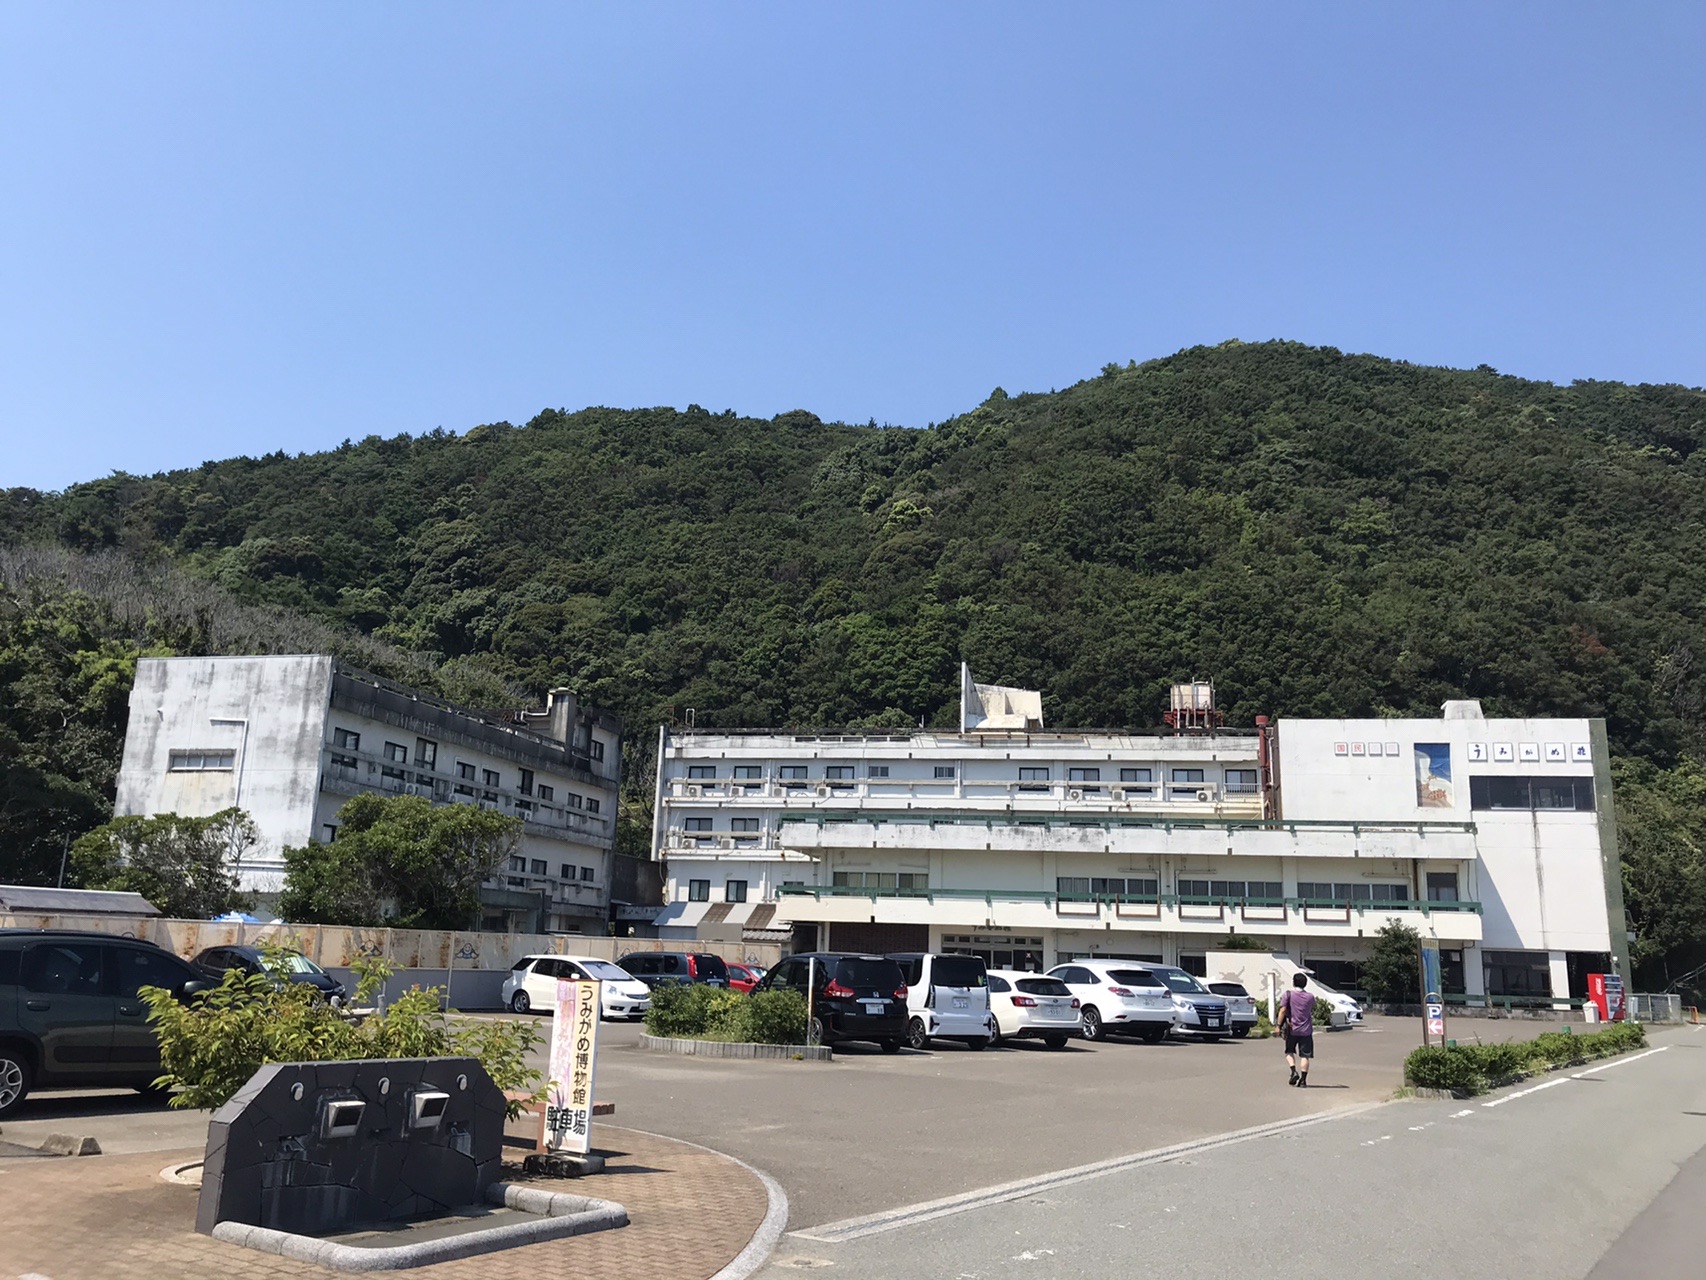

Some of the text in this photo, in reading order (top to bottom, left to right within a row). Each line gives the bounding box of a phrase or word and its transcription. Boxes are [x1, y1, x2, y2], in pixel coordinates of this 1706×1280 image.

[1429, 1006, 1440, 1018] P
[571, 985, 594, 1105] うみがめ博物館
[546, 1105, 587, 1136] 駐車場
